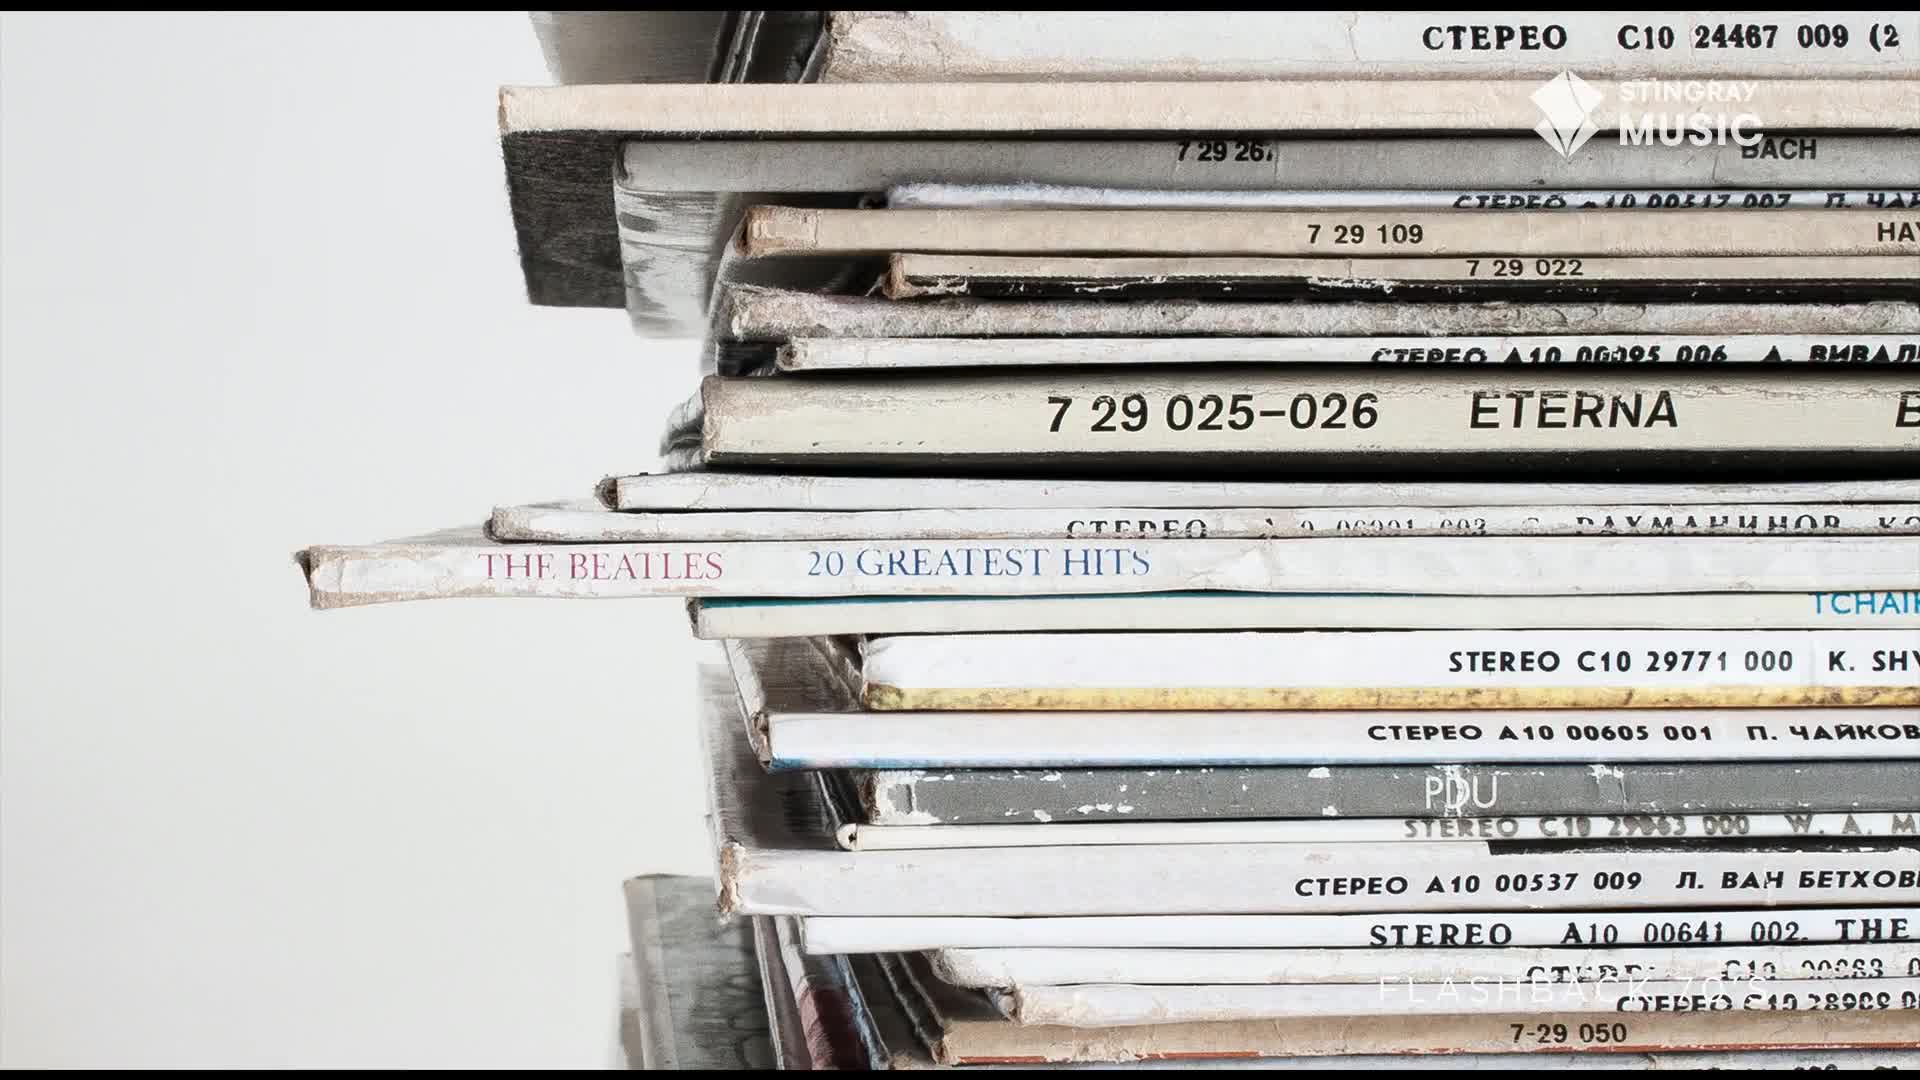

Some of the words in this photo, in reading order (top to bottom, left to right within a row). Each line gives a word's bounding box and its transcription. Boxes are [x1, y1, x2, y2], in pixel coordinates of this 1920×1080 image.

[1423, 25, 1568, 51] СТЕРЕО
[1618, 25, 1675, 50] С10
[1695, 24, 1779, 49] 24467
[1797, 24, 1850, 49] 009
[1741, 138, 1817, 160] BACH
[1307, 224, 1322, 243] 7
[1334, 225, 1365, 244] 29
[1377, 224, 1424, 244] 109
[1467, 260, 1480, 277] 7
[1493, 260, 1524, 277] 29
[1536, 259, 1584, 276] 022
[1048, 396, 1073, 432] 7
[1091, 395, 1149, 432] 29
[1470, 390, 1679, 429] ETERNA
[478, 553, 555, 580] THE
[568, 551, 723, 580] BEATLES
[807, 551, 845, 577] 20
[856, 548, 1049, 577] GREATEST
[1062, 548, 1152, 576] HITS
[1449, 650, 1561, 673] STEREO
[1577, 650, 1631, 672] C10
[1646, 650, 1728, 672] 29771
[1744, 650, 1794, 672] 000
[1828, 650, 1855, 671] K.
[1368, 724, 1483, 742] СТЕРЕО
[1498, 724, 1554, 741] А10
[1566, 724, 1650, 741] 00605
[1663, 724, 1713, 741] 001
[1746, 724, 1778, 741] П.
[1425, 774, 1498, 810] PDU
[1404, 818, 1520, 839] STEREO
[1701, 815, 1751, 836] 000
[1784, 814, 1826, 835] W.
[1842, 814, 1873, 835] A.
[1295, 875, 1409, 898] СТЕРЕО
[1425, 874, 1482, 895] А10
[1494, 873, 1579, 893] 00537
[1592, 872, 1643, 891] 009
[1675, 871, 1704, 889] Л.
[1721, 871, 1784, 889] ВАН
[1370, 922, 1513, 947] STEREO
[1560, 922, 1619, 945] A10
[1642, 921, 1724, 944] 00641
[1835, 917, 1911, 941] THE
[1509, 1022, 1568, 1043] 7-29
[1579, 1022, 1628, 1043] 050
